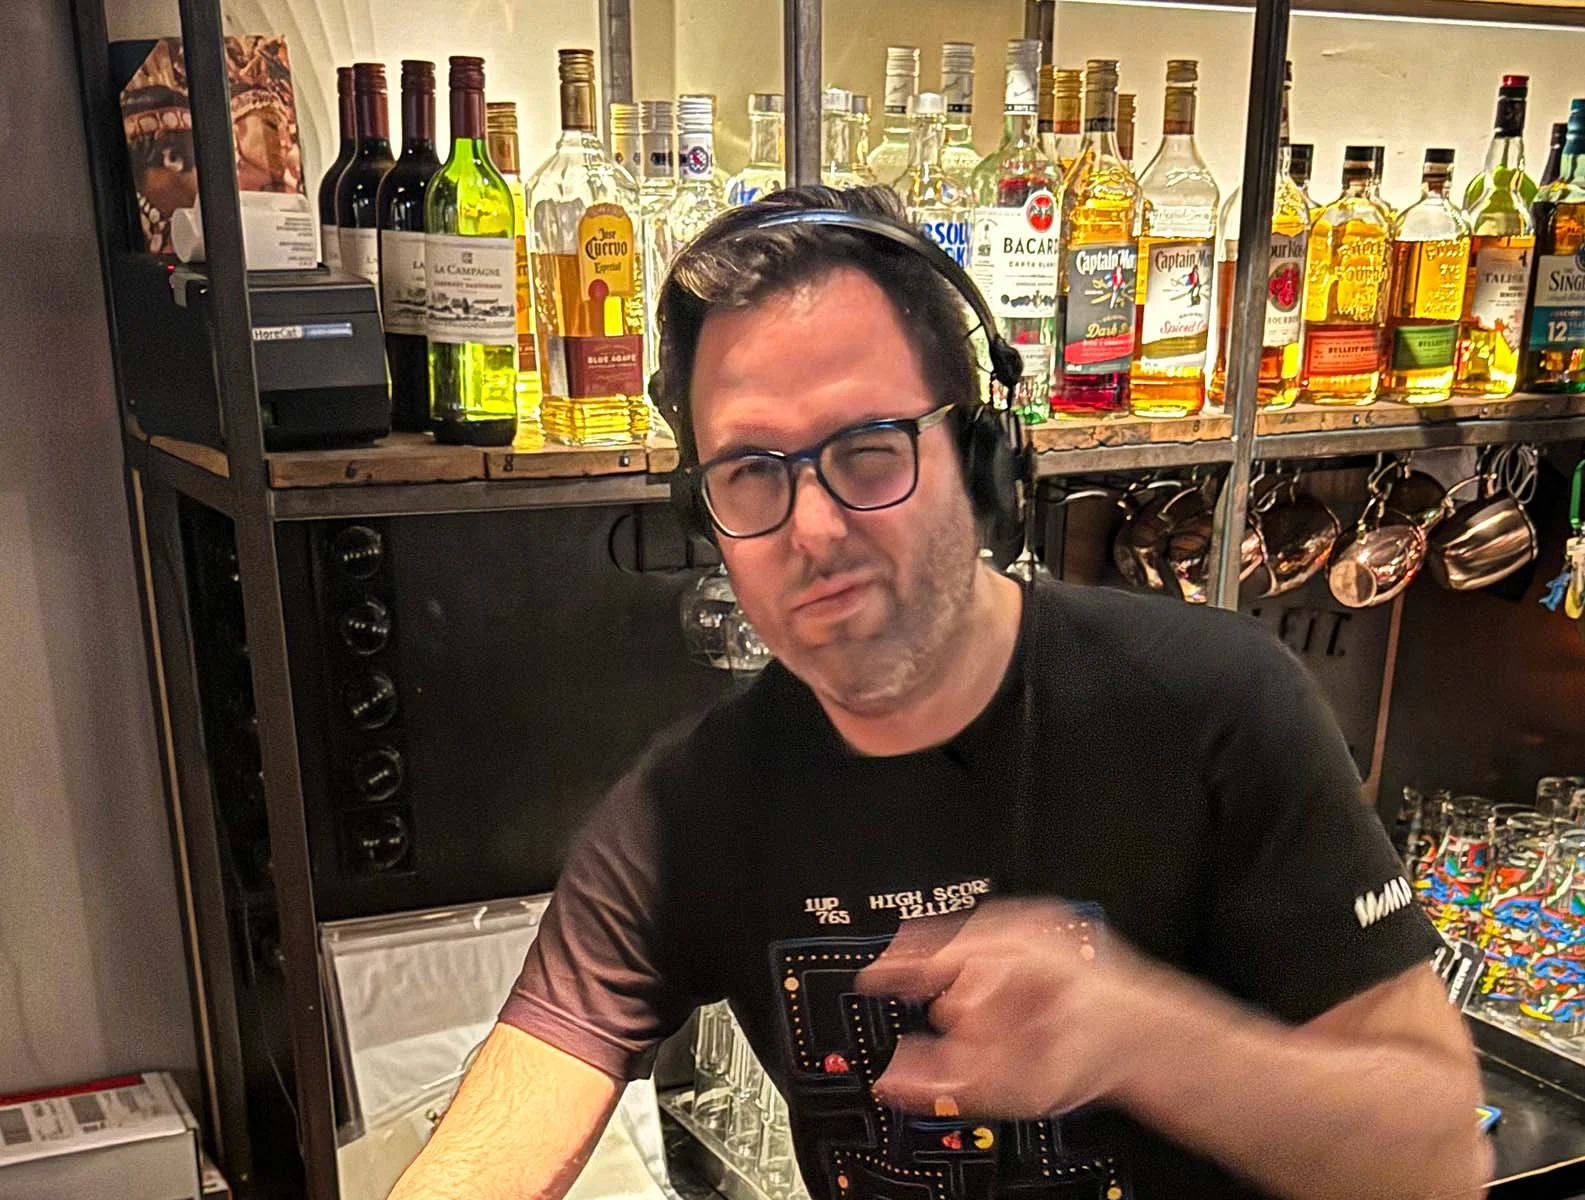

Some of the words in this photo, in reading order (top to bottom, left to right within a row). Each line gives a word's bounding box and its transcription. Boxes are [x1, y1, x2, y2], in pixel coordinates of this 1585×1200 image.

[585, 236, 628, 260] Cuervo
[434, 264, 445, 274] LA
[447, 264, 500, 277] CAMPAGNE
[594, 262, 621, 274] Especial
[1075, 248, 1118, 276] Captain
[1155, 249, 1196, 273] Captain
[1548, 320, 1568, 342] 12
[587, 356, 608, 364] BLUE
[611, 354, 637, 363] AGAVE
[804, 897, 839, 912] 1UP
[869, 890, 923, 910] HIGH
[899, 896, 976, 920] 121129
[816, 910, 850, 925] 765
